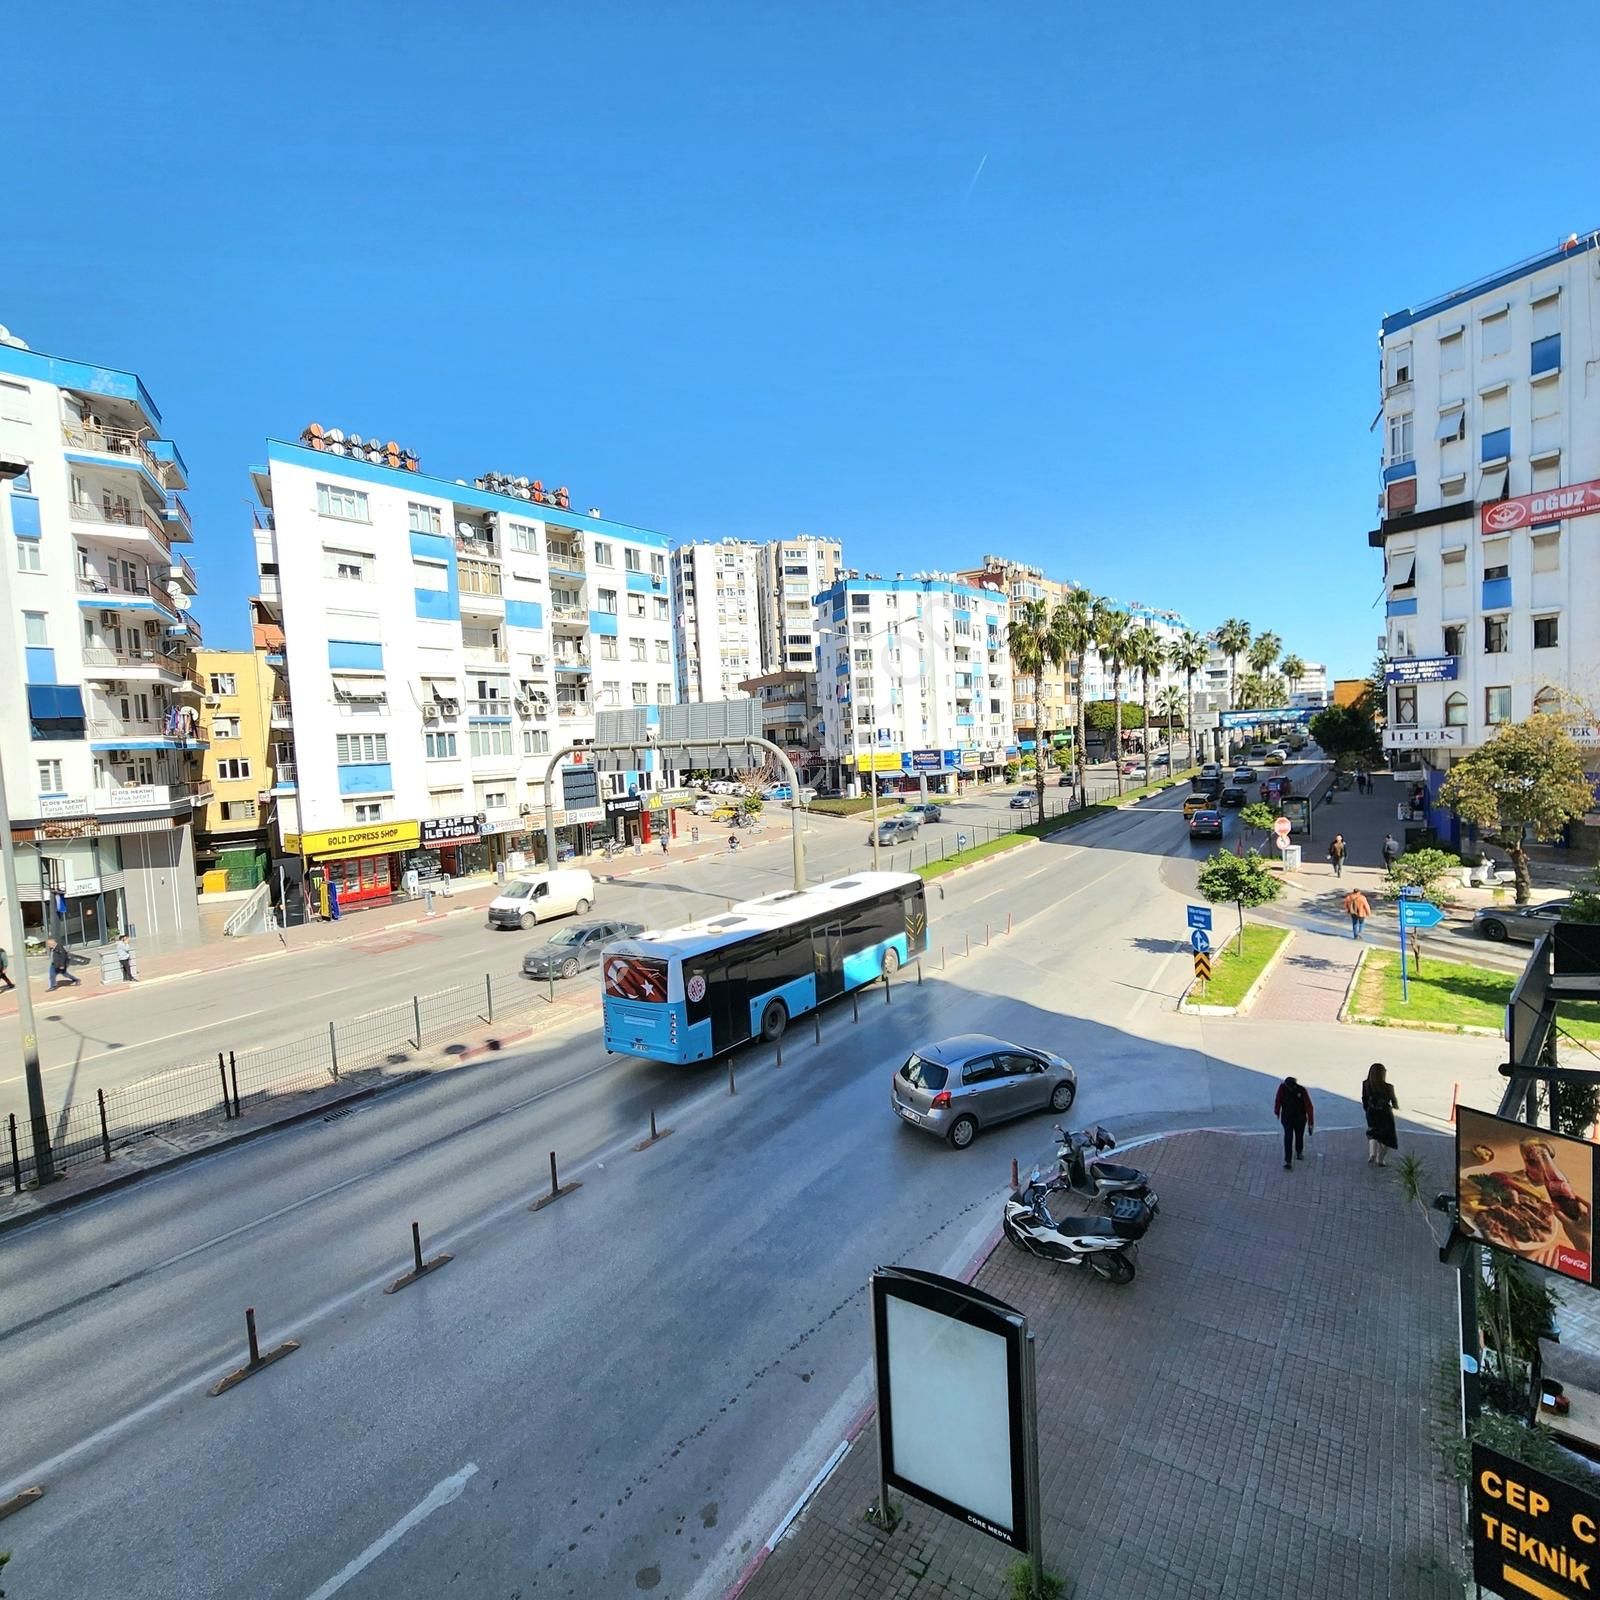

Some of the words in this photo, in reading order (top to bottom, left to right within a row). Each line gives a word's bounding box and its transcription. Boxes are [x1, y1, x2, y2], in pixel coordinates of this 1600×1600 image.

[1531, 489, 1585, 514] OĞUZ
[328, 836, 346, 846] GOLD
[348, 831, 380, 843] EXPRESS
[380, 828, 398, 839] SHOP
[424, 824, 475, 839] İLETİŞİM
[1480, 1470, 1550, 1518] CEP
[1571, 1513, 1600, 1545] C
[967, 1515, 987, 1530] CORE
[987, 1525, 1012, 1542] MEDYA
[1481, 1512, 1591, 1590] TEKNİK
